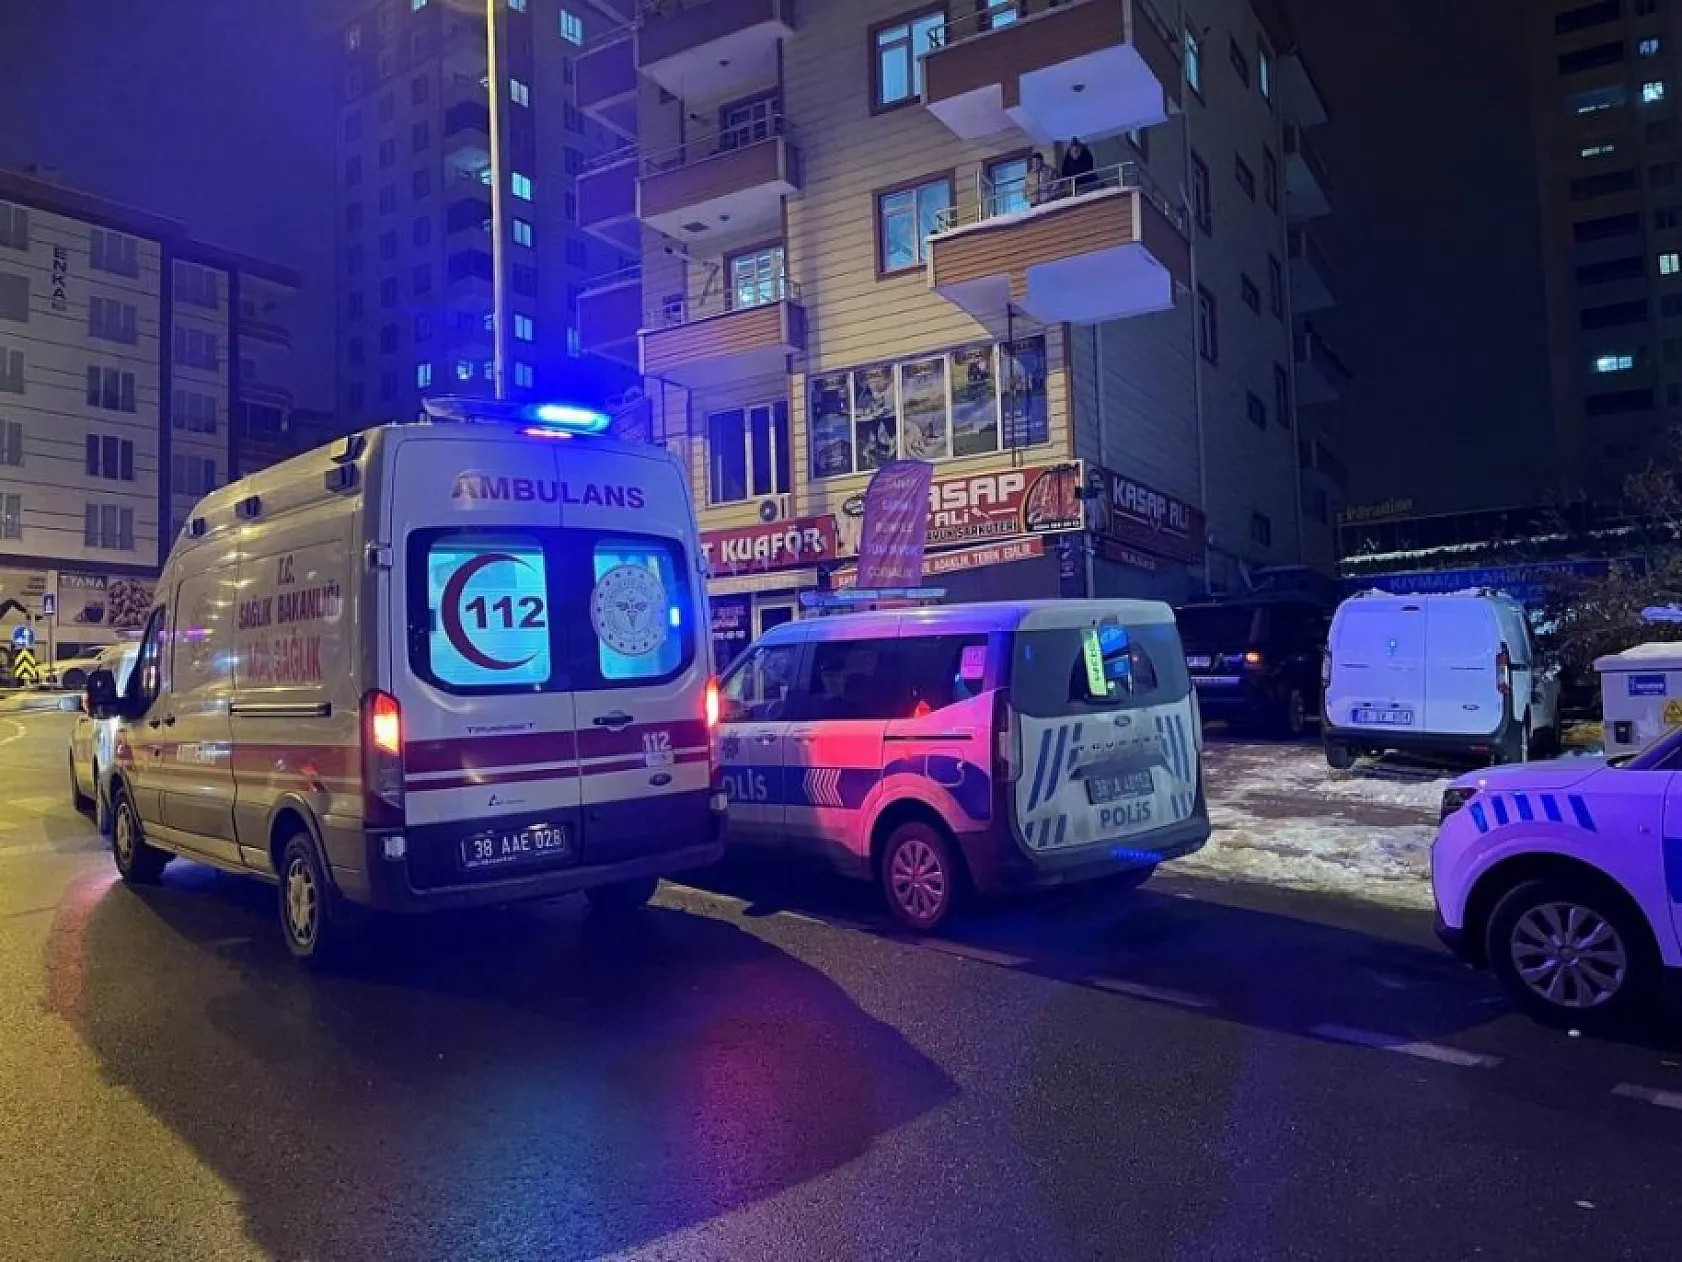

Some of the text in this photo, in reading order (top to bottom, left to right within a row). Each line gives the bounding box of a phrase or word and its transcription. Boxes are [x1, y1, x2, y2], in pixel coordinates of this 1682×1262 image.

[451, 474, 645, 509] AMBULANS
[1113, 476, 1166, 520] KASAP
[722, 524, 821, 563] KUAFÖR
[465, 595, 546, 629] 112
[642, 731, 672, 753] 112
[1100, 801, 1151, 829] POLİS
[474, 838, 493, 858] 38
[501, 833, 530, 855] AAE
